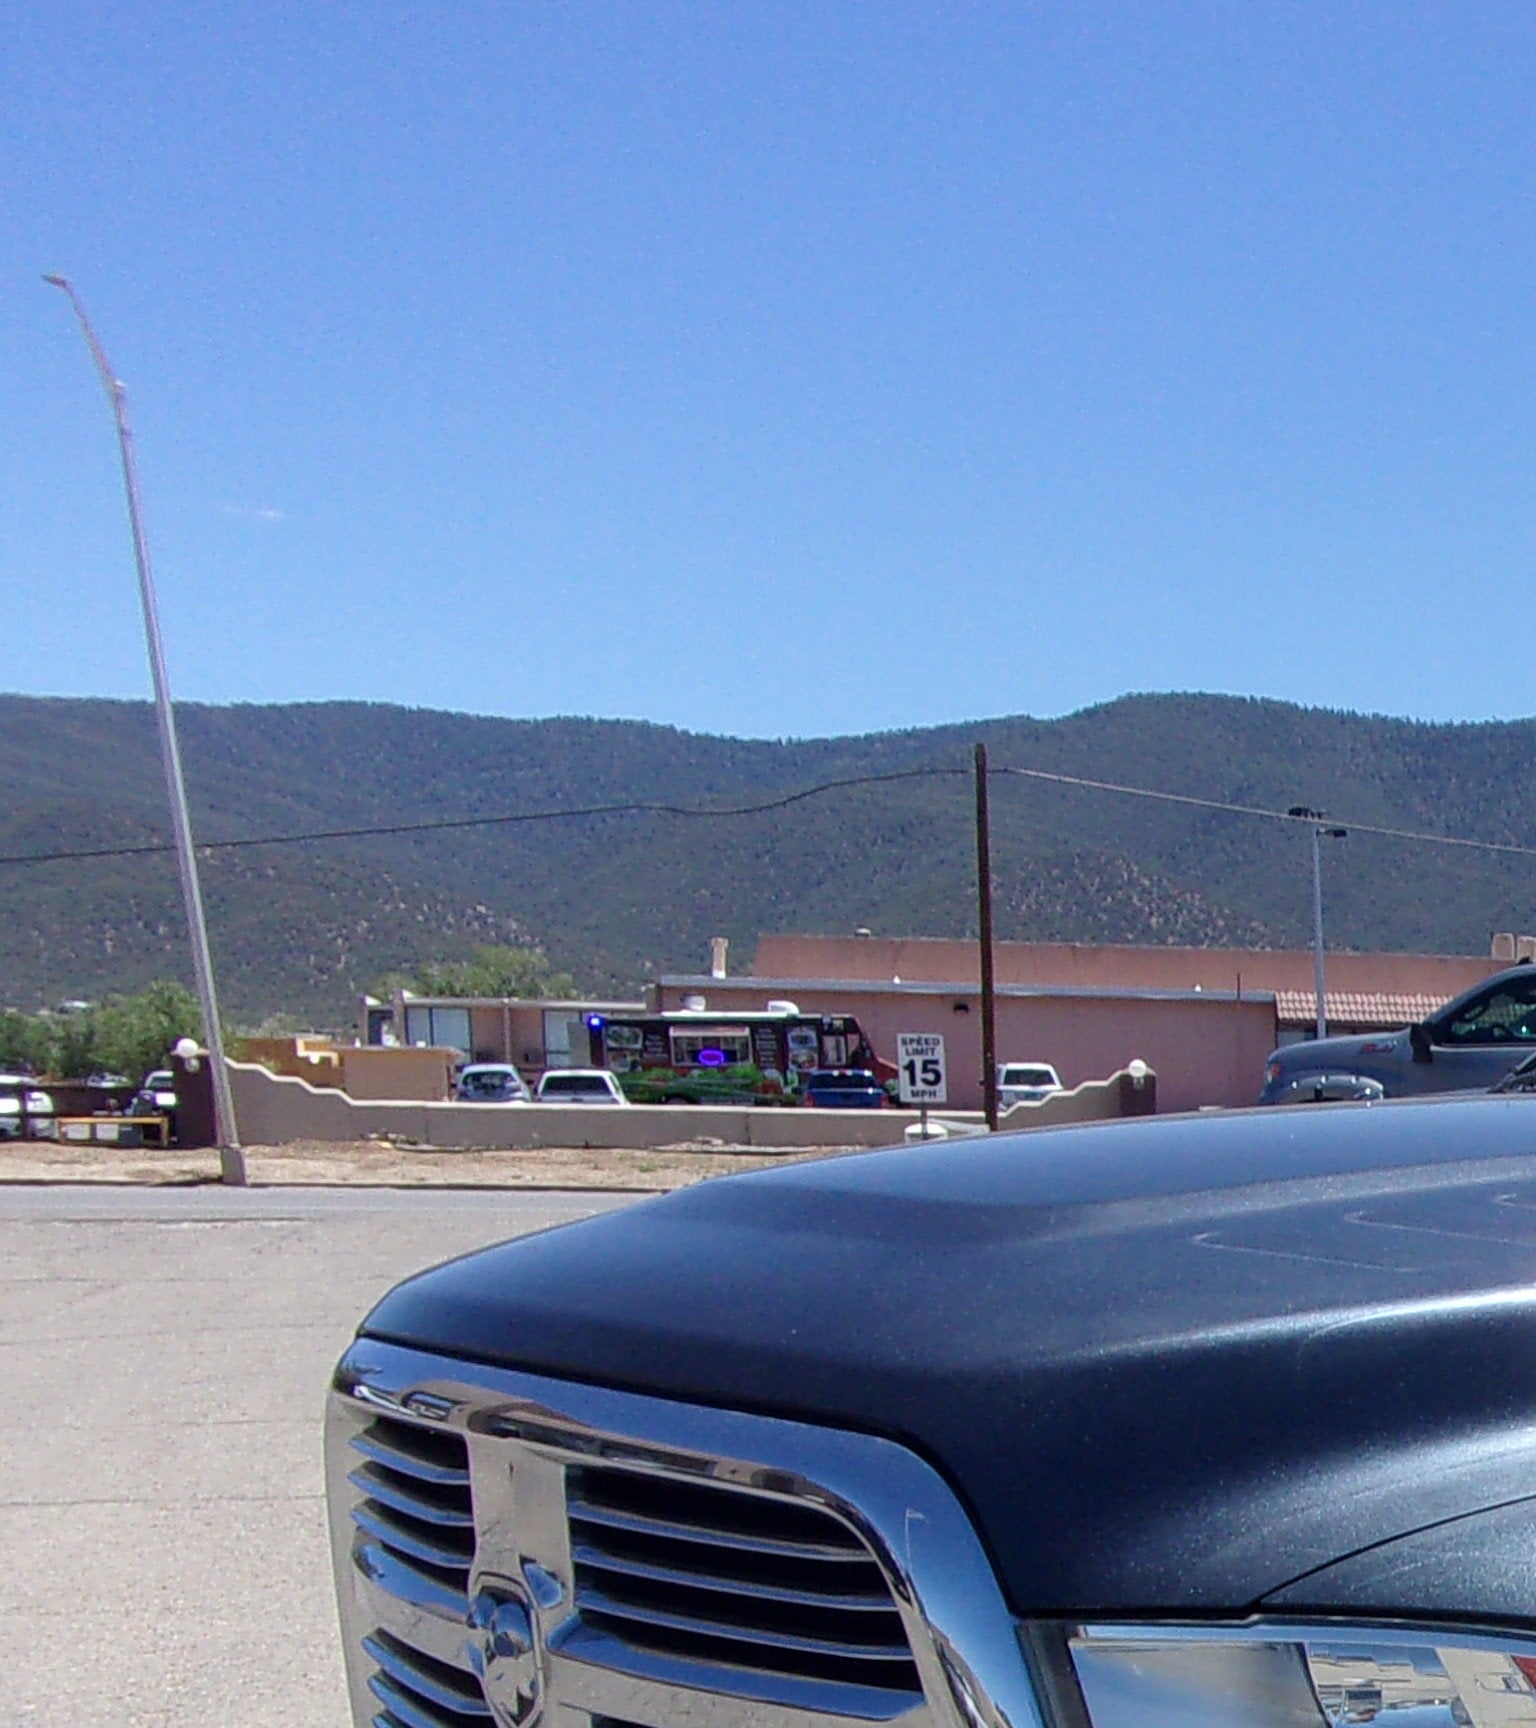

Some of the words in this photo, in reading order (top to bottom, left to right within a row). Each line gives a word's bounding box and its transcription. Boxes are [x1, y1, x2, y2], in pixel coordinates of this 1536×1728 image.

[901, 1036, 940, 1046] SPEED
[905, 1048, 936, 1057] LIMIT
[902, 1059, 942, 1087] 15
[910, 1089, 937, 1099] MPH
